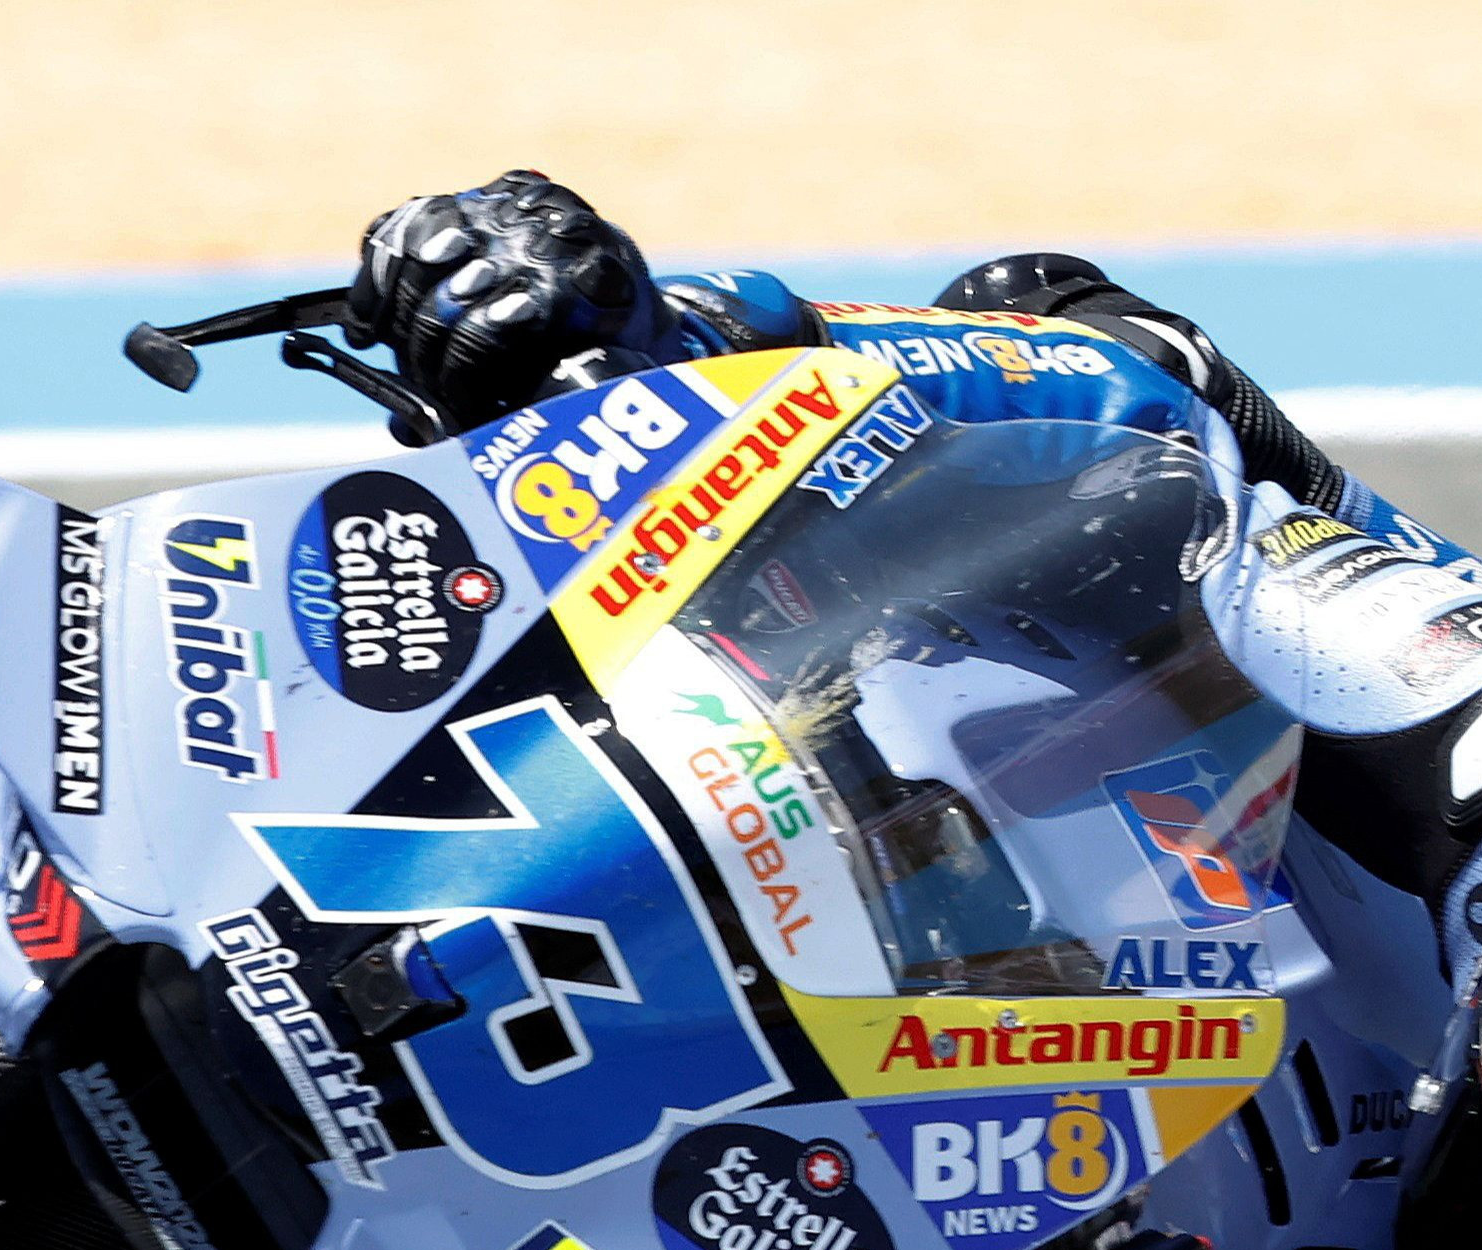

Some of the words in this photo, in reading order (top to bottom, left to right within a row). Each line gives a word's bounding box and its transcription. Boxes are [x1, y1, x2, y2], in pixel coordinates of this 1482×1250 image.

[856, 336, 975, 377] NEW
[471, 407, 548, 481] NEWS
[503, 378, 688, 548] BK8
[588, 369, 846, 617] Antangin
[796, 384, 934, 509] ALEX
[59, 581, 102, 696] GLOW
[163, 513, 262, 783] Unibat
[332, 516, 390, 670] Galicia
[384, 508, 449, 673] Estrella
[724, 740, 814, 840] AUS
[688, 747, 821, 957] GLOBAL
[1106, 937, 1265, 990] ALEX
[879, 1006, 1242, 1076] Antangin
[913, 1108, 1126, 1208] BK8
[944, 1206, 1038, 1238] NEWS
